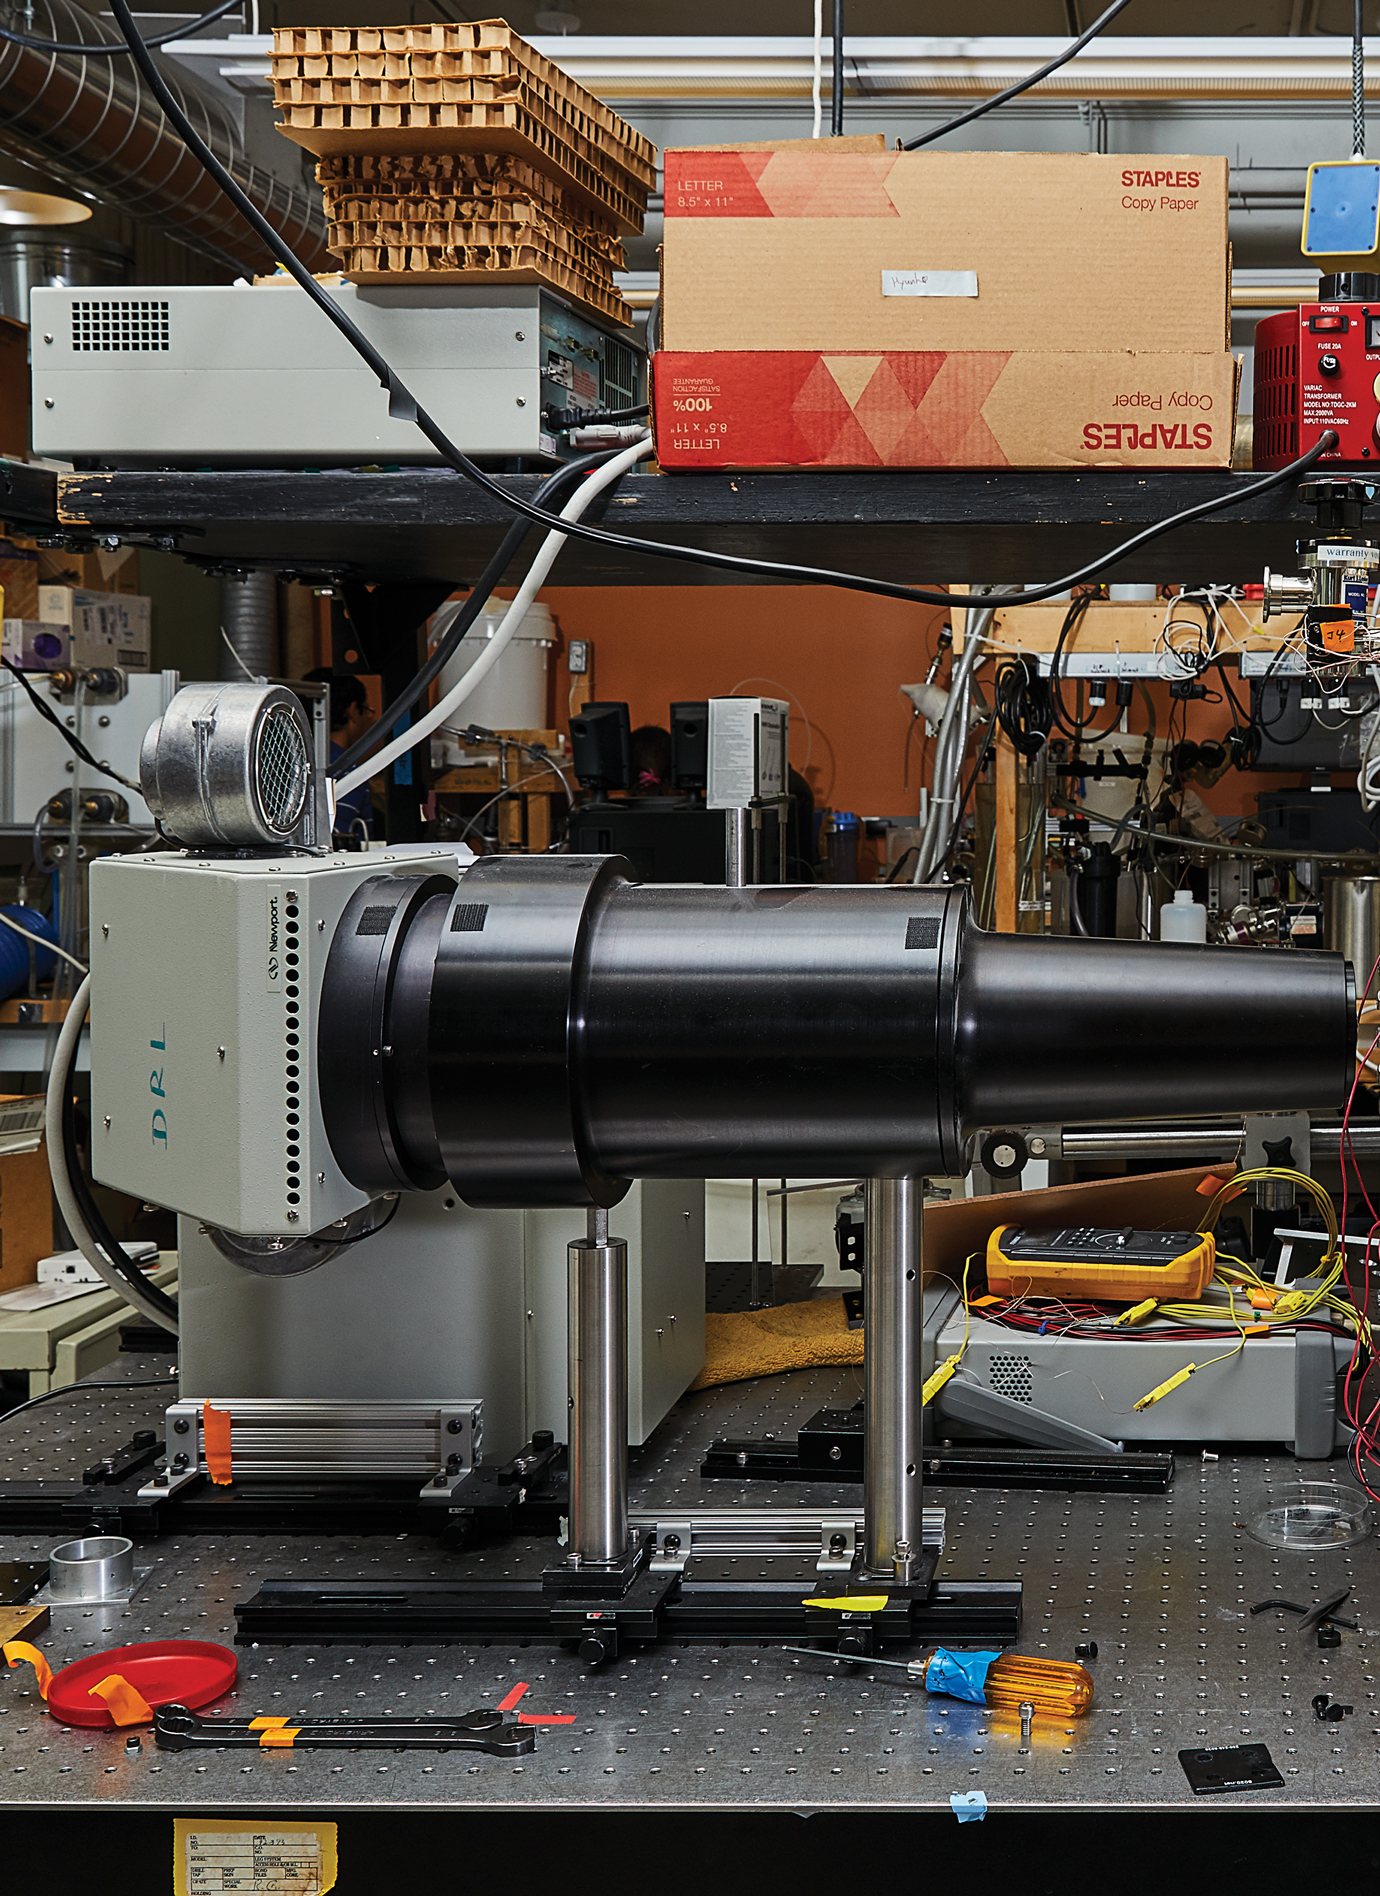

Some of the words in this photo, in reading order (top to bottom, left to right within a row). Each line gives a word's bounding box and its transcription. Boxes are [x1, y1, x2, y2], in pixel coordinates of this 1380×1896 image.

[678, 180, 724, 191] LETTER
[1121, 170, 1200, 188] STAPLES
[678, 196, 701, 208] 8.5"
[704, 199, 712, 208] x
[715, 196, 734, 208] 11"
[1121, 195, 1156, 212] Copy
[1160, 196, 1200, 212] Paper
[673, 398, 712, 412] 100%
[1112, 391, 1162, 410] Paper
[1168, 391, 1213, 411] Copy
[670, 423, 688, 433] 11"
[704, 423, 728, 433] 8.5"
[1080, 423, 1213, 450] STAPLES
[673, 439, 720, 450] LETTER
[1326, 548, 1369, 560] warranty
